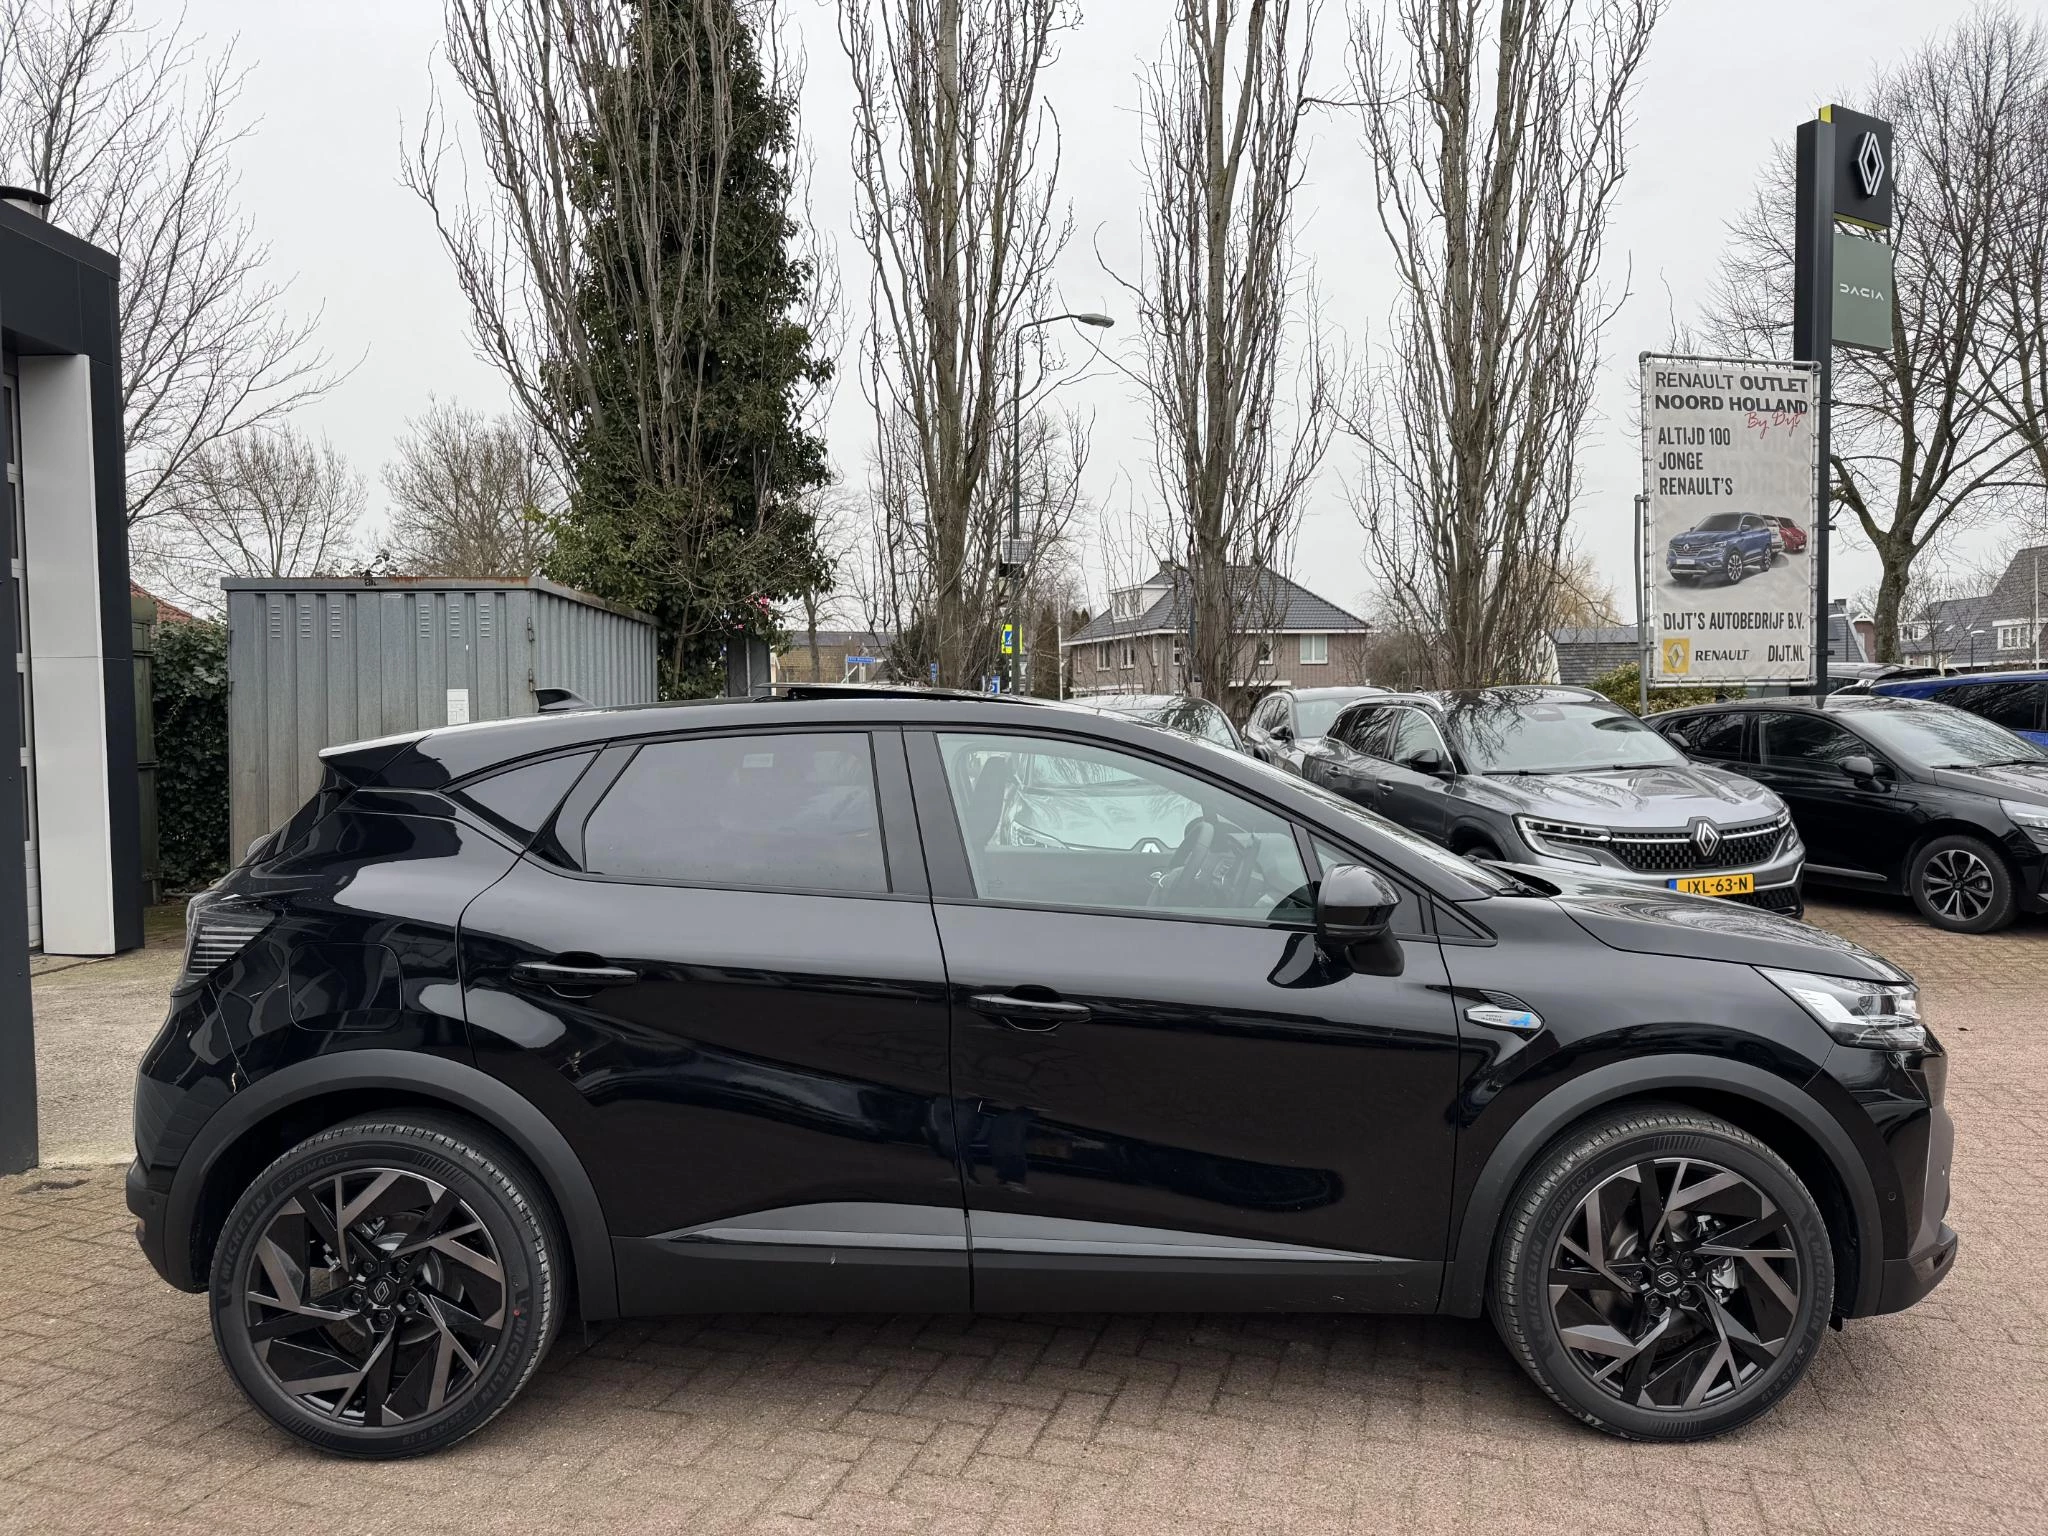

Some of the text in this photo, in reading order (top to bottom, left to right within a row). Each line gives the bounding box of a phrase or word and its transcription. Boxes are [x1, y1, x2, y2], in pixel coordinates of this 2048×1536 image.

[1840, 283, 1885, 301] DACIA
[1655, 371, 1808, 393] RENAULT OUTLET
[1655, 394, 1808, 414] NOORD HOLLAND
[1744, 411, 1769, 440] By
[1658, 426, 1731, 446] ALTIJD 100
[1658, 451, 1704, 470] JONGE
[1659, 477, 1733, 496] RENAULT'S
[1663, 612, 1805, 630] DIJT'S AUTOBEDRIJF B.V.
[1695, 645, 1805, 662] RENAULT DIJT.NL
[218, 1191, 269, 1279] MICHELIN
[1526, 1238, 1544, 1332] MICHELIN
